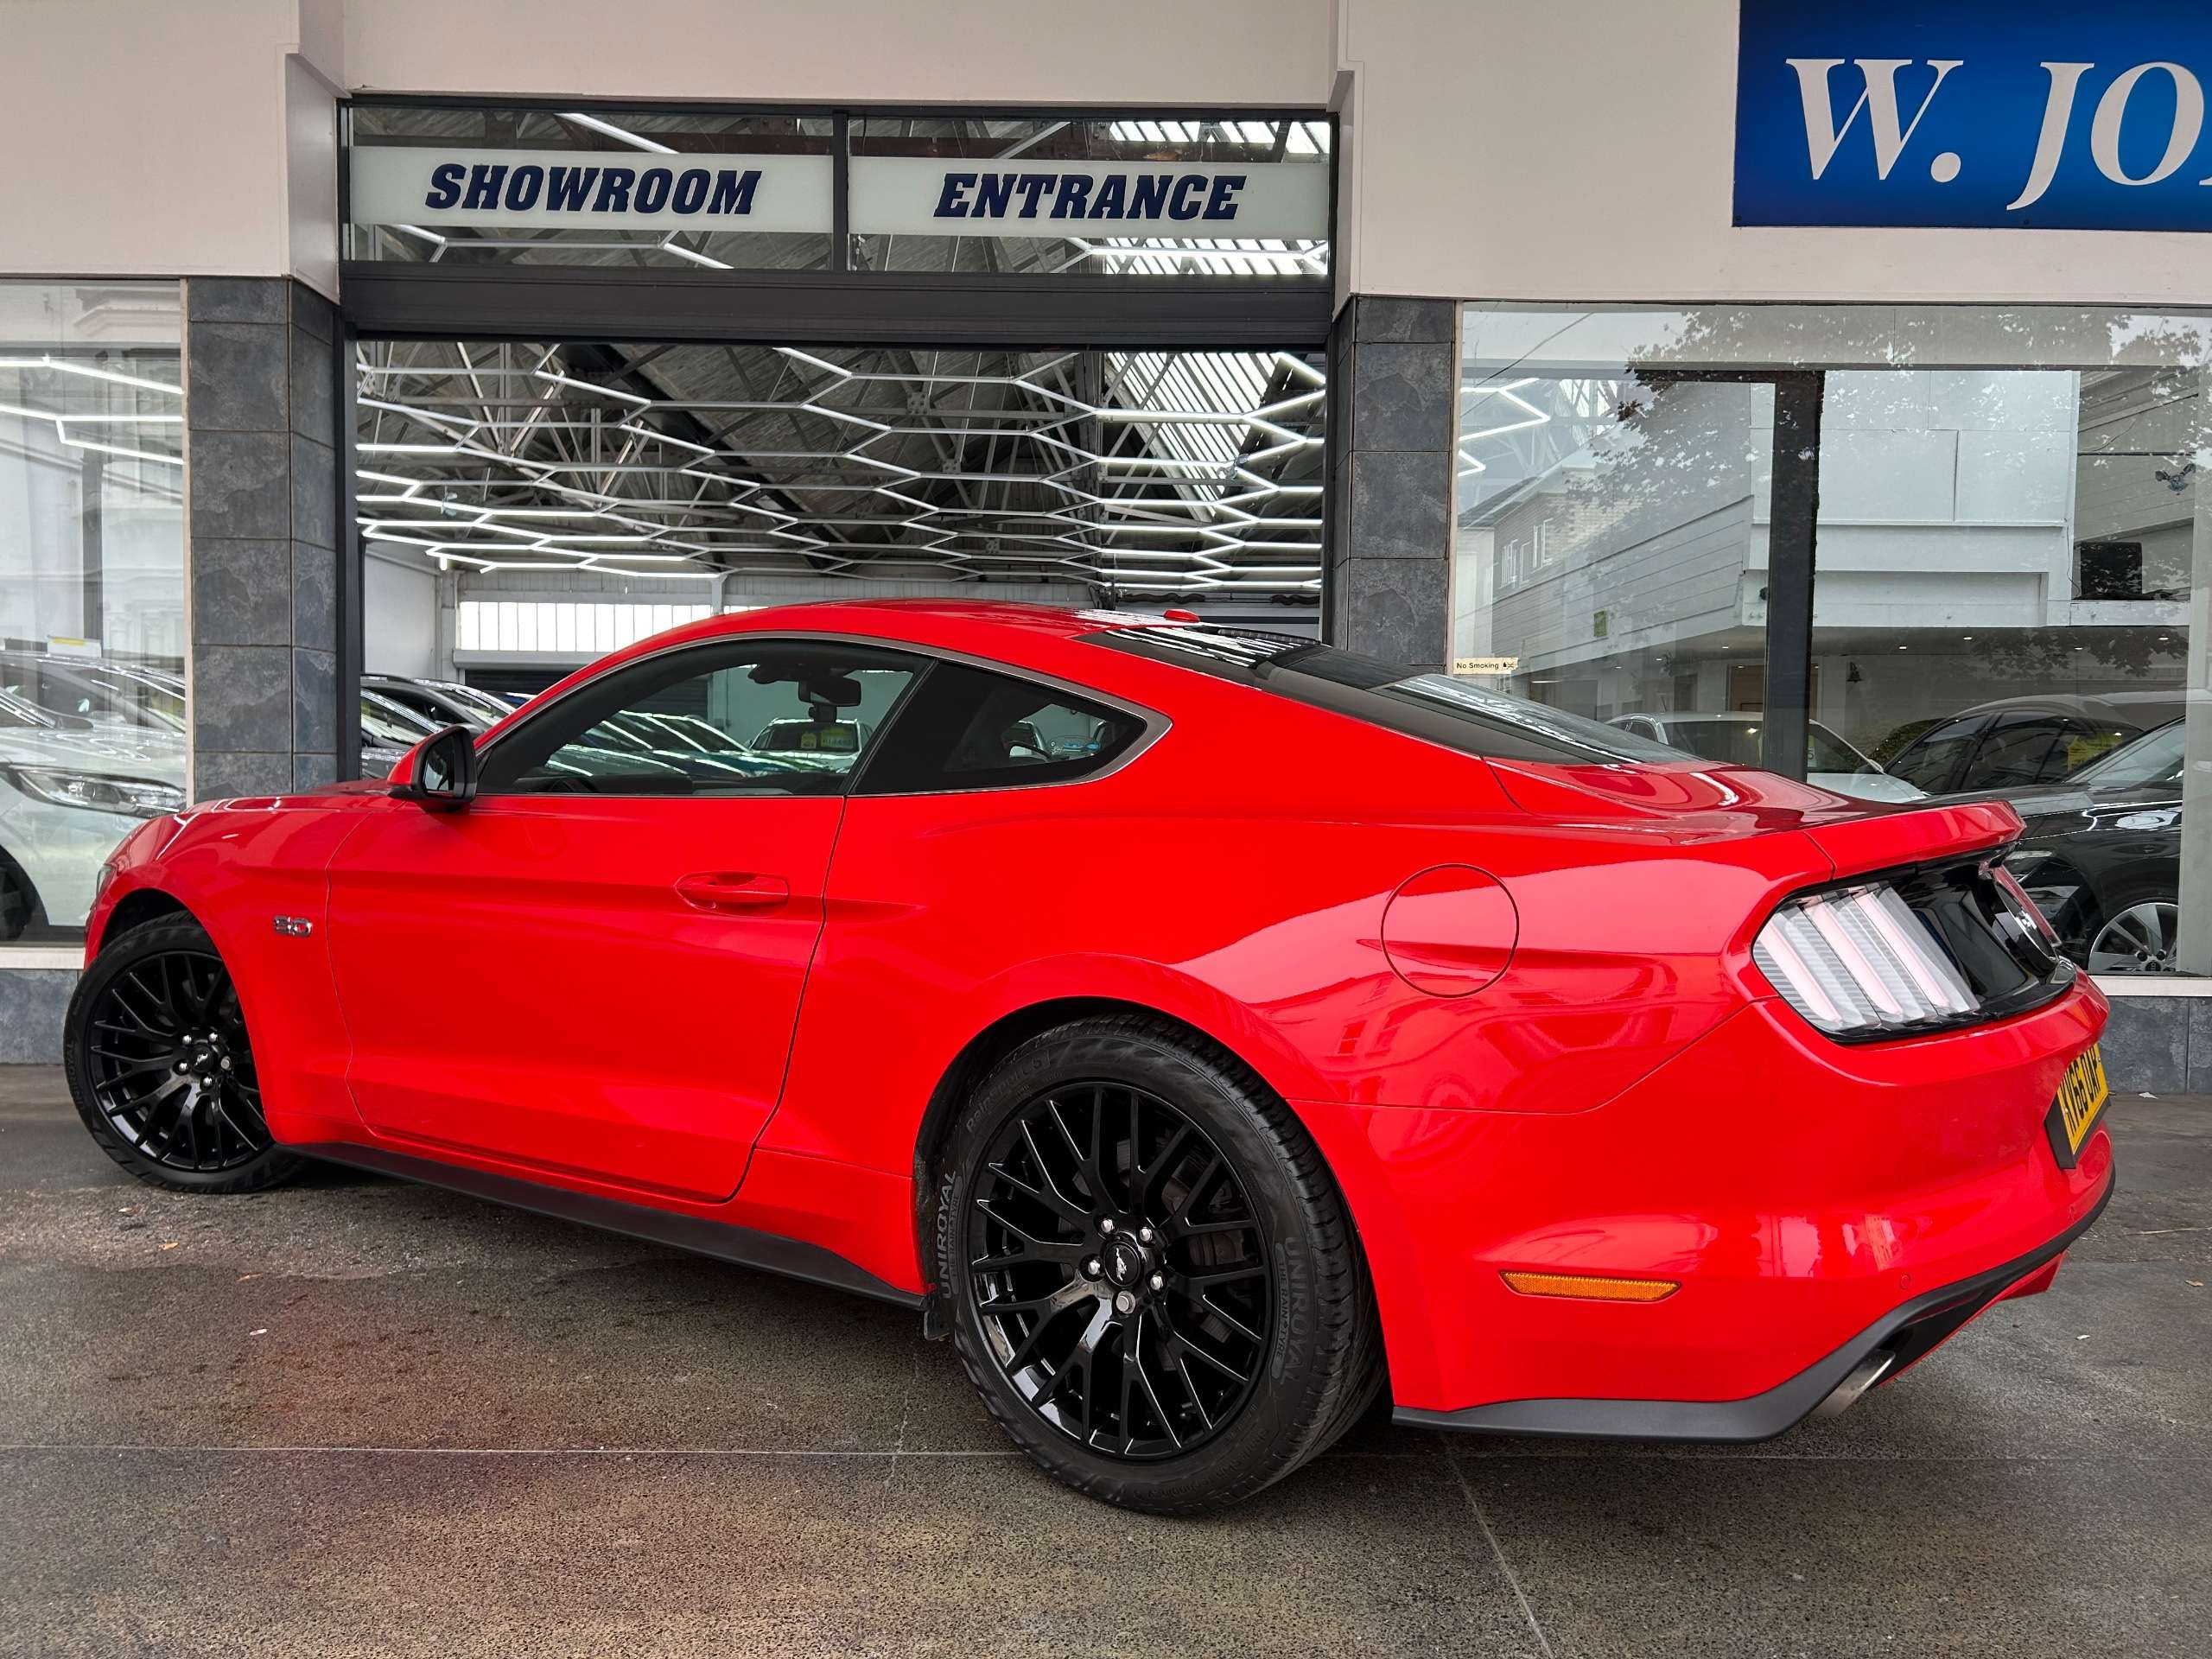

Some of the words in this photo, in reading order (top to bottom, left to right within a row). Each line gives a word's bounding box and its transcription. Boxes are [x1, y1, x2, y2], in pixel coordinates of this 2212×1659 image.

[1785, 58, 1964, 183] W.
[2006, 60, 2212, 211] JO
[424, 162, 763, 215] SHOWROOM
[933, 172, 1247, 221] ENTRANCE
[1469, 662, 1499, 671] Smoking
[937, 1171, 957, 1299] UNIROYAL
[1278, 1262, 1287, 1285] THE
[1280, 1290, 1290, 1319] RAIN
[1275, 1330, 1289, 1357] TYRE
